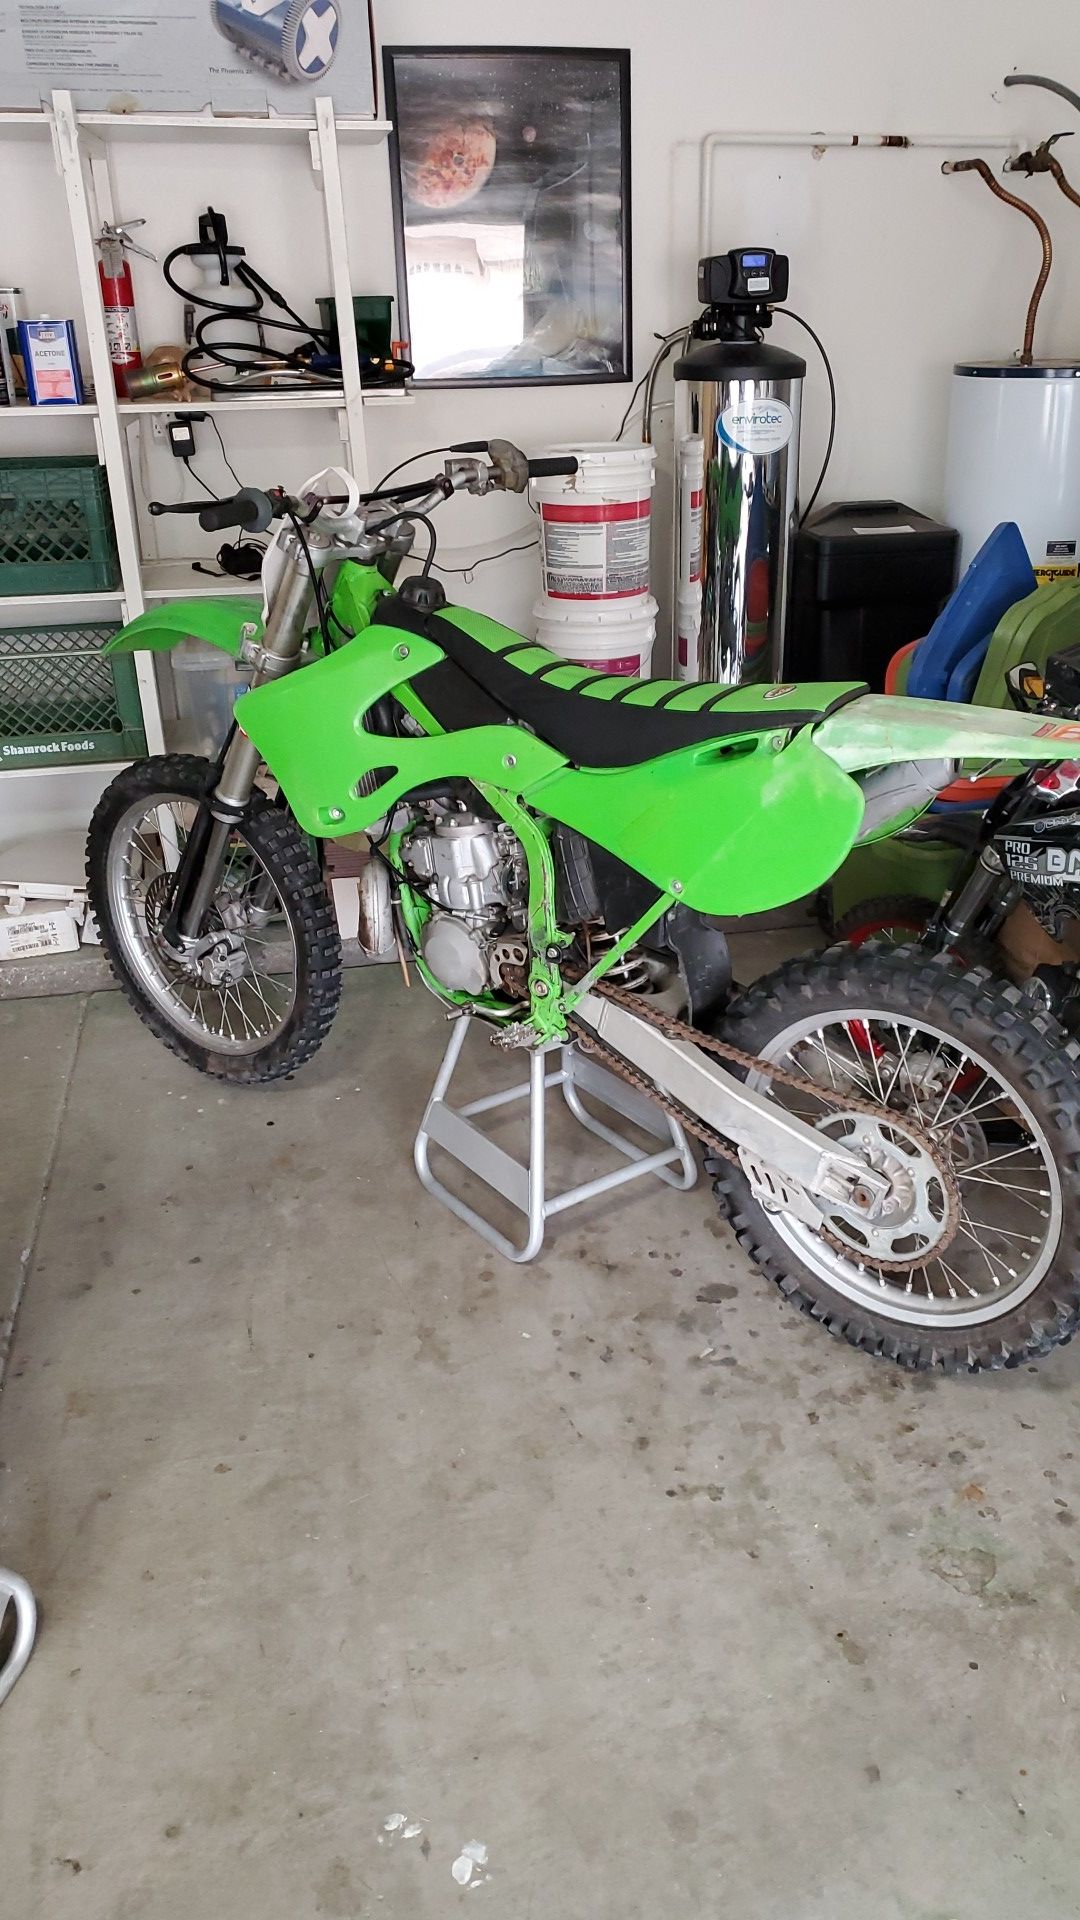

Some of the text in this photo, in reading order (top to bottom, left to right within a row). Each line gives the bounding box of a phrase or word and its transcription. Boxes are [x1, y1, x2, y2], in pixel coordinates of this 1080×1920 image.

[731, 411, 782, 425] envirotec
[1034, 568, 1076, 578] ERGYGUIDE
[2, 740, 95, 756] Shamrock Foods
[1005, 840, 1031, 855] PRO
[1005, 853, 1038, 871] 125
[1010, 869, 1064, 887] PREMIUM
